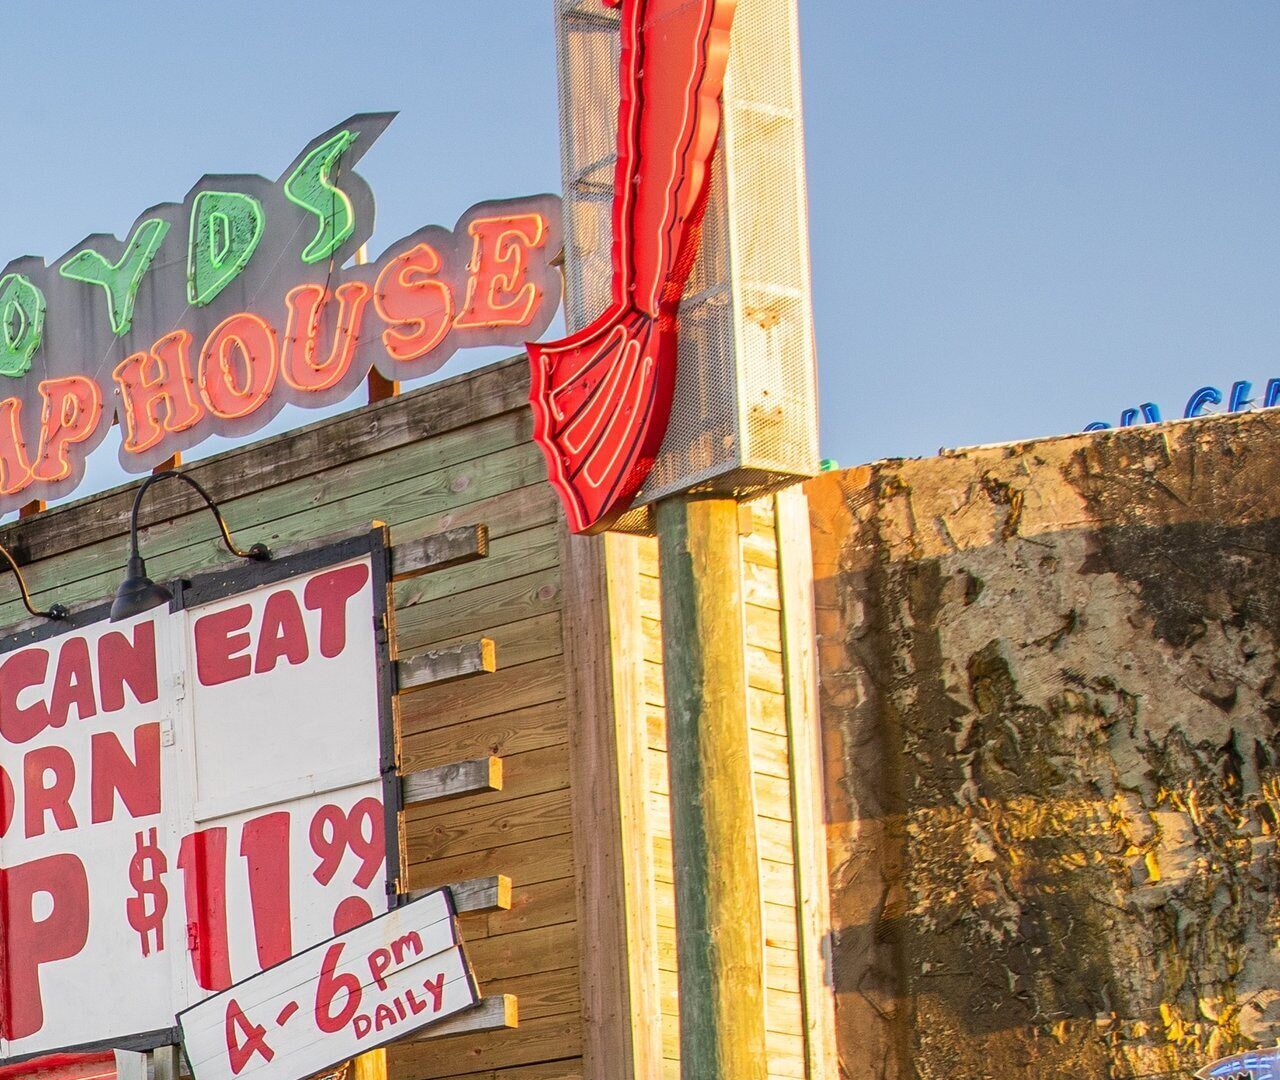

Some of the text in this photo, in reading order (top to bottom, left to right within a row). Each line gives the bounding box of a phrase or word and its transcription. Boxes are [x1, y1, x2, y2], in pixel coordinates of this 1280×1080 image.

[113, 212, 549, 454] HOUSE
[194, 563, 370, 687] EAT
[352, 972, 445, 1041] DAILY
